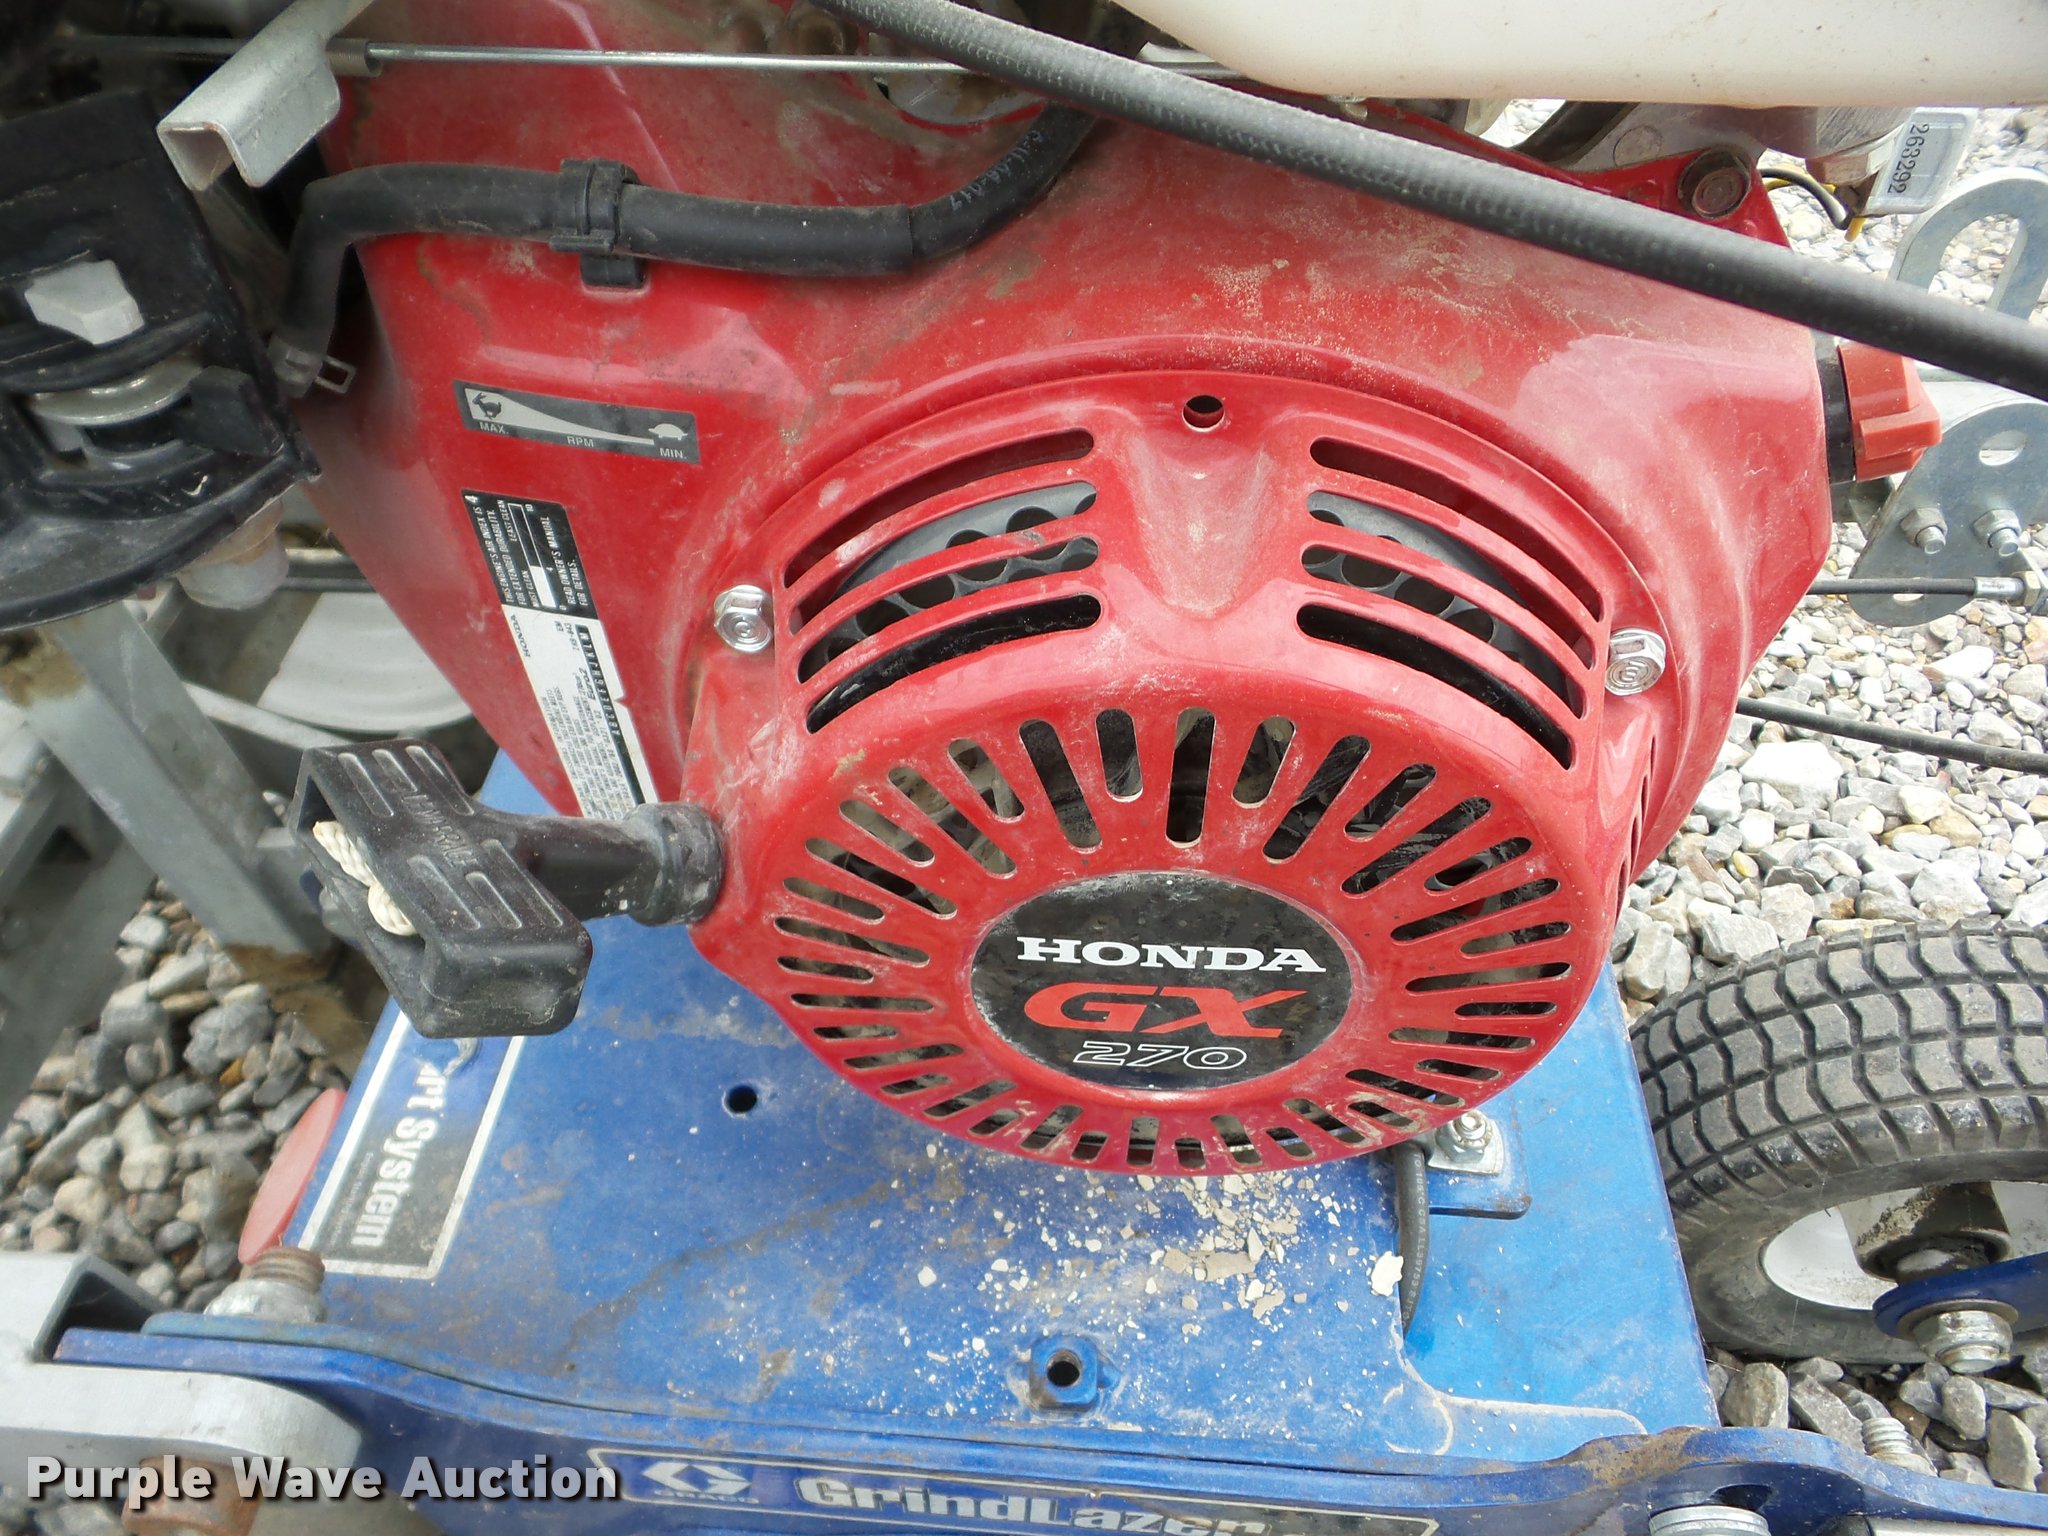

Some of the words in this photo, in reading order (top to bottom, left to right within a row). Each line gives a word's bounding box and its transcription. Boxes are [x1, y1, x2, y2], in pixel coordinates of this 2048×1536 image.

[1888, 123, 1930, 194] 263292
[479, 422, 509, 435] MAX.
[567, 436, 594, 448] RPM
[659, 448, 688, 460] MIN.
[497, 499, 510, 520] CLEAN
[476, 516, 491, 538] INDEX
[505, 521, 517, 541] LEAST
[540, 515, 558, 548] MANUAL
[485, 540, 496, 552] AIR
[502, 554, 521, 589] EXTENDED
[551, 550, 570, 584] OWNER'S
[521, 569, 534, 589] CLEAN
[515, 591, 527, 604] FOR
[563, 586, 576, 604] READ
[577, 592, 588, 605] FOR
[510, 613, 530, 656] HONDA
[579, 667, 596, 700] Euro2
[1016, 936, 1327, 973] HONDA
[1024, 982, 1308, 1038] GX
[1073, 1040, 1247, 1069] 270
[351, 1116, 439, 1247] System
